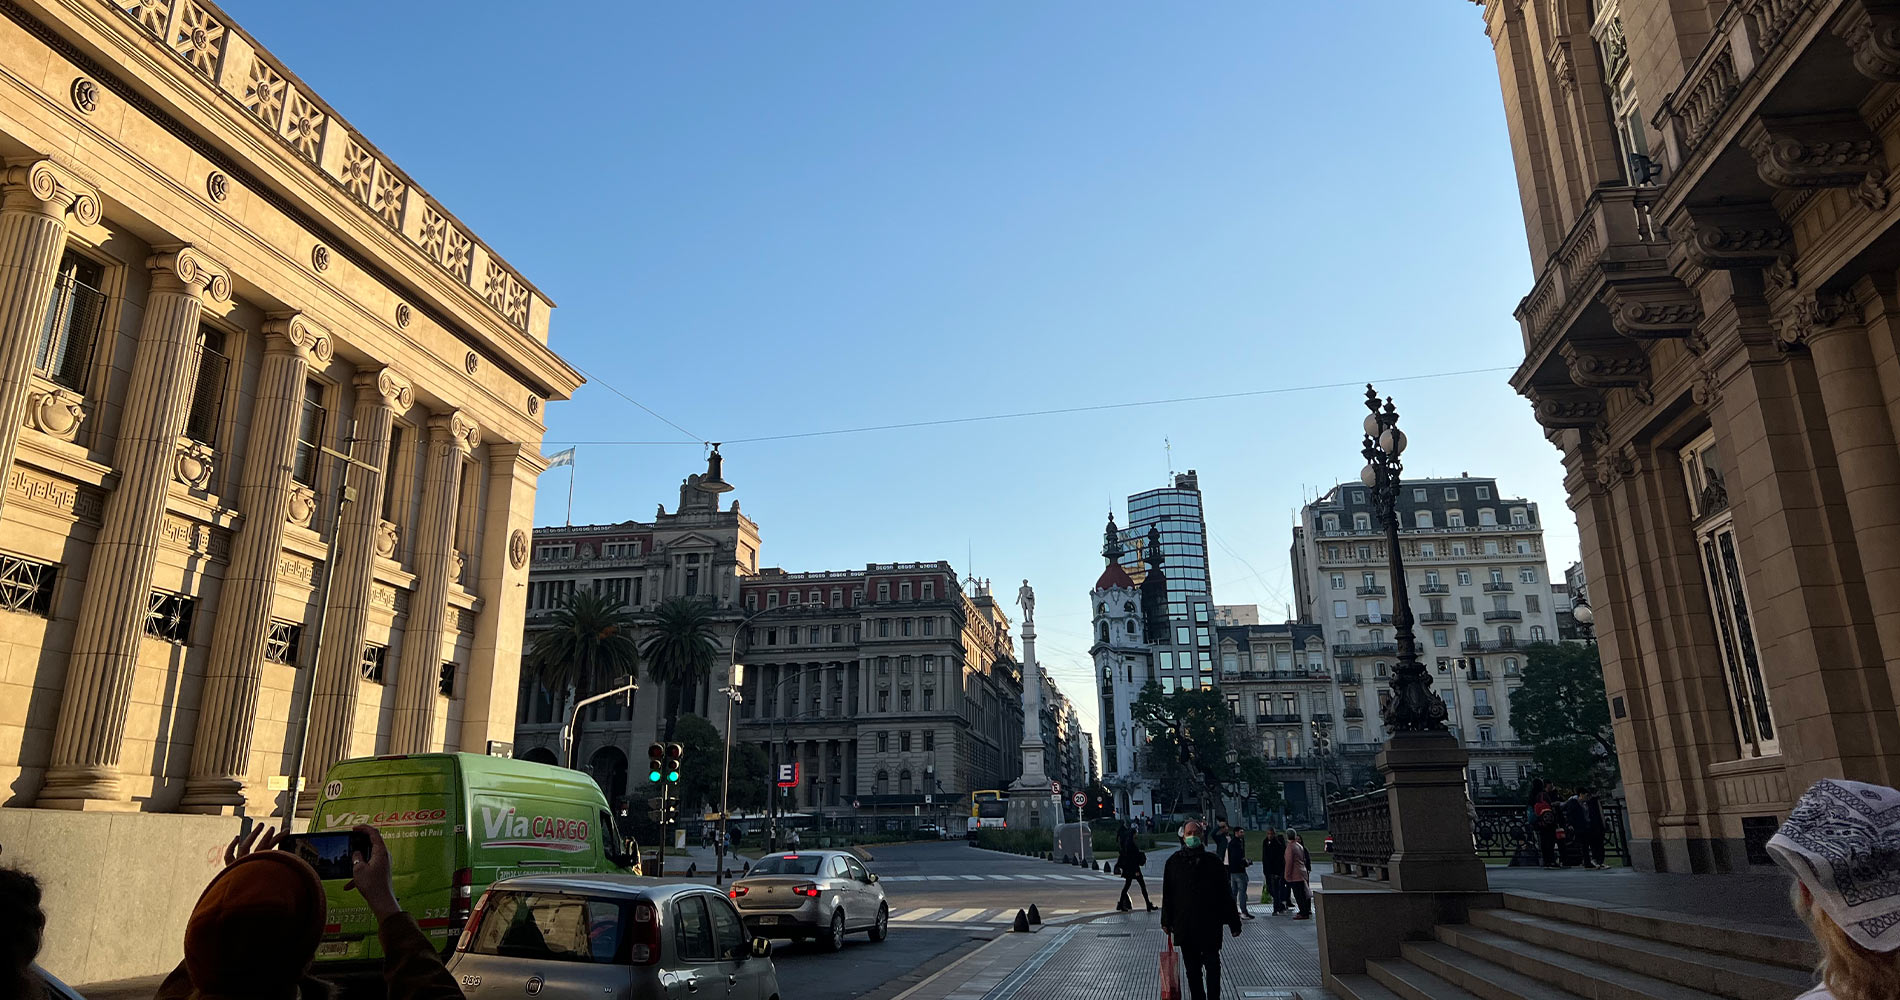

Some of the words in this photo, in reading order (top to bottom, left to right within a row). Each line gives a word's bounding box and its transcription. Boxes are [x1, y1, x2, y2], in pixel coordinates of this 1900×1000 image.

[780, 764, 791, 780] E
[327, 783, 341, 796] 110
[1075, 795, 1085, 803] 20
[373, 809, 446, 823] CARGO
[481, 807, 529, 839] Via
[532, 815, 588, 841] CARGO
